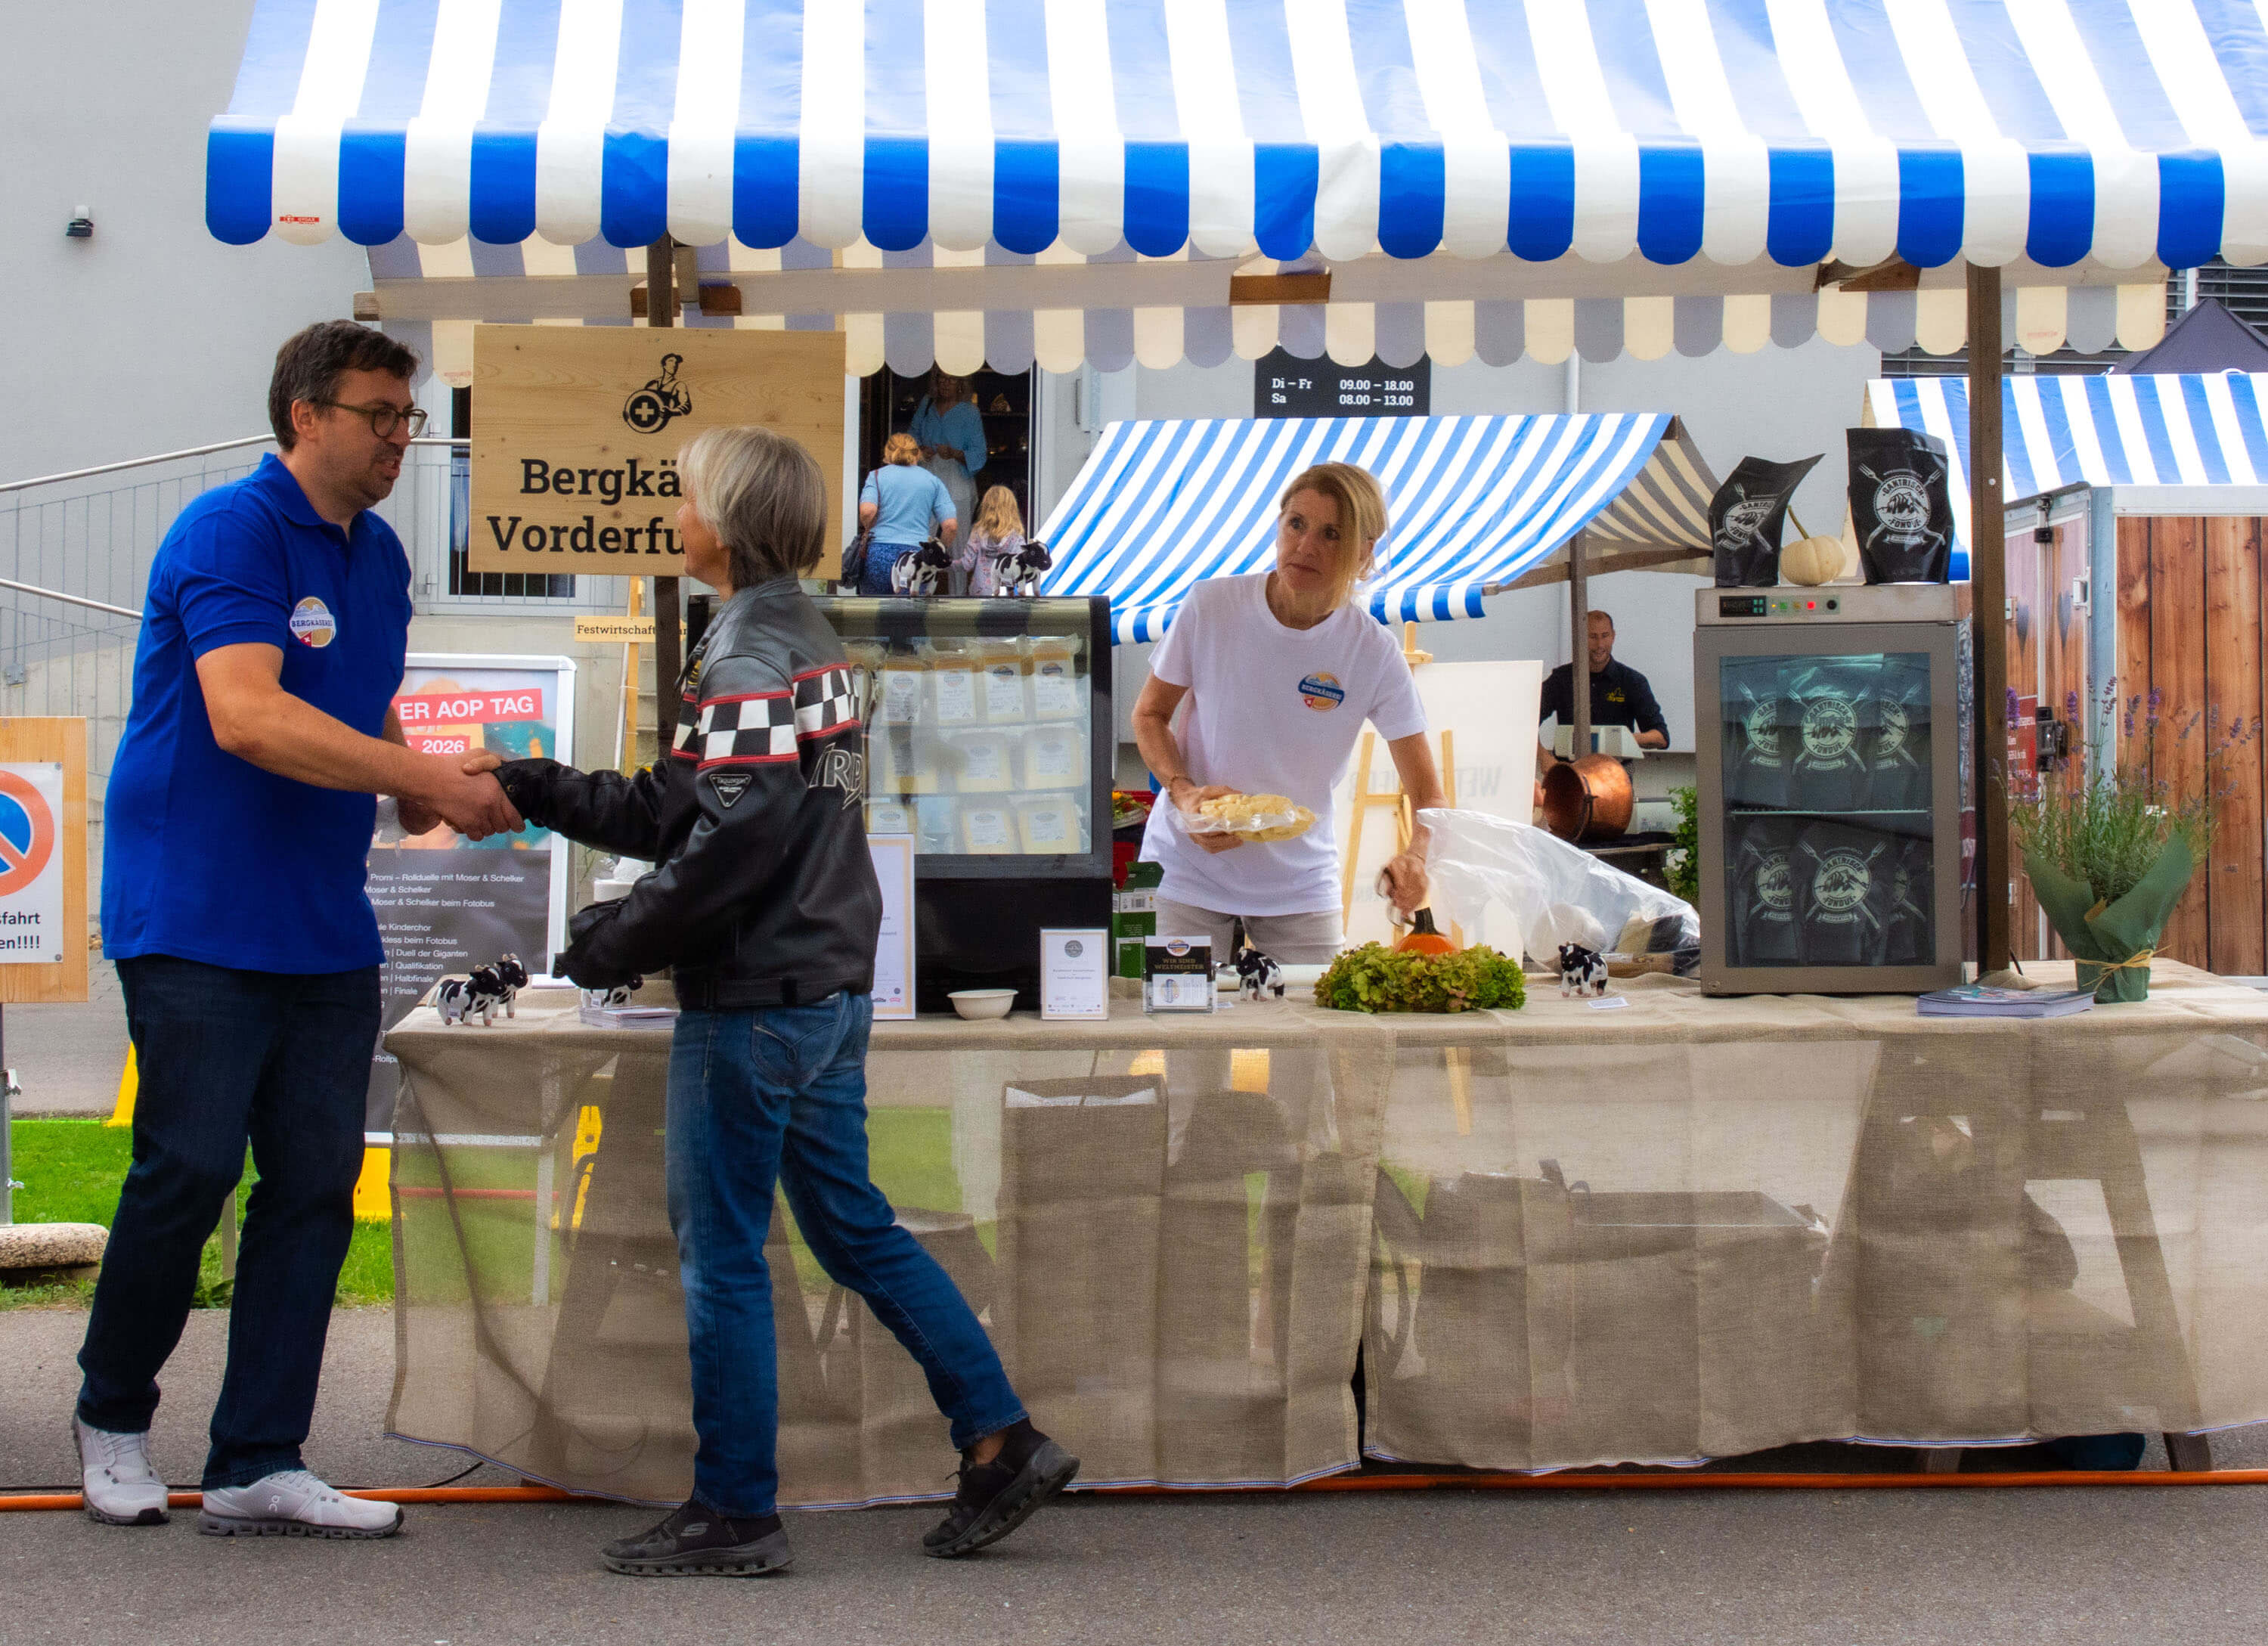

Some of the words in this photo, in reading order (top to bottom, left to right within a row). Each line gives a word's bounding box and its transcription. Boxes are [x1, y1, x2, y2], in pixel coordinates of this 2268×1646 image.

[1272, 378, 1284, 389] Di
[1299, 379, 1312, 389] Fr
[1340, 380, 1371, 390] 09.00
[1384, 380, 1414, 391] 18.00
[1272, 393, 1287, 404] Sa
[1339, 395, 1371, 405] 08.00
[1383, 395, 1414, 406] 13.00
[520, 458, 683, 505] Bergkä
[487, 516, 686, 554] Vorderfu
[577, 625, 656, 635] Festwirtschaft
[400, 702, 429, 721] ER
[437, 699, 483, 719] AOP
[490, 696, 534, 715] TAG
[422, 739, 465, 755] 2026
[441, 873, 454, 882] mit
[389, 923, 432, 931] Kinderchor
[426, 937, 457, 945] Fotobus
[396, 949, 416, 957] Duell
[433, 950, 468, 959] Giganten
[395, 961, 444, 970] Qualifikation
[395, 974, 434, 983] Halbfinale
[395, 987, 418, 995] Finale
